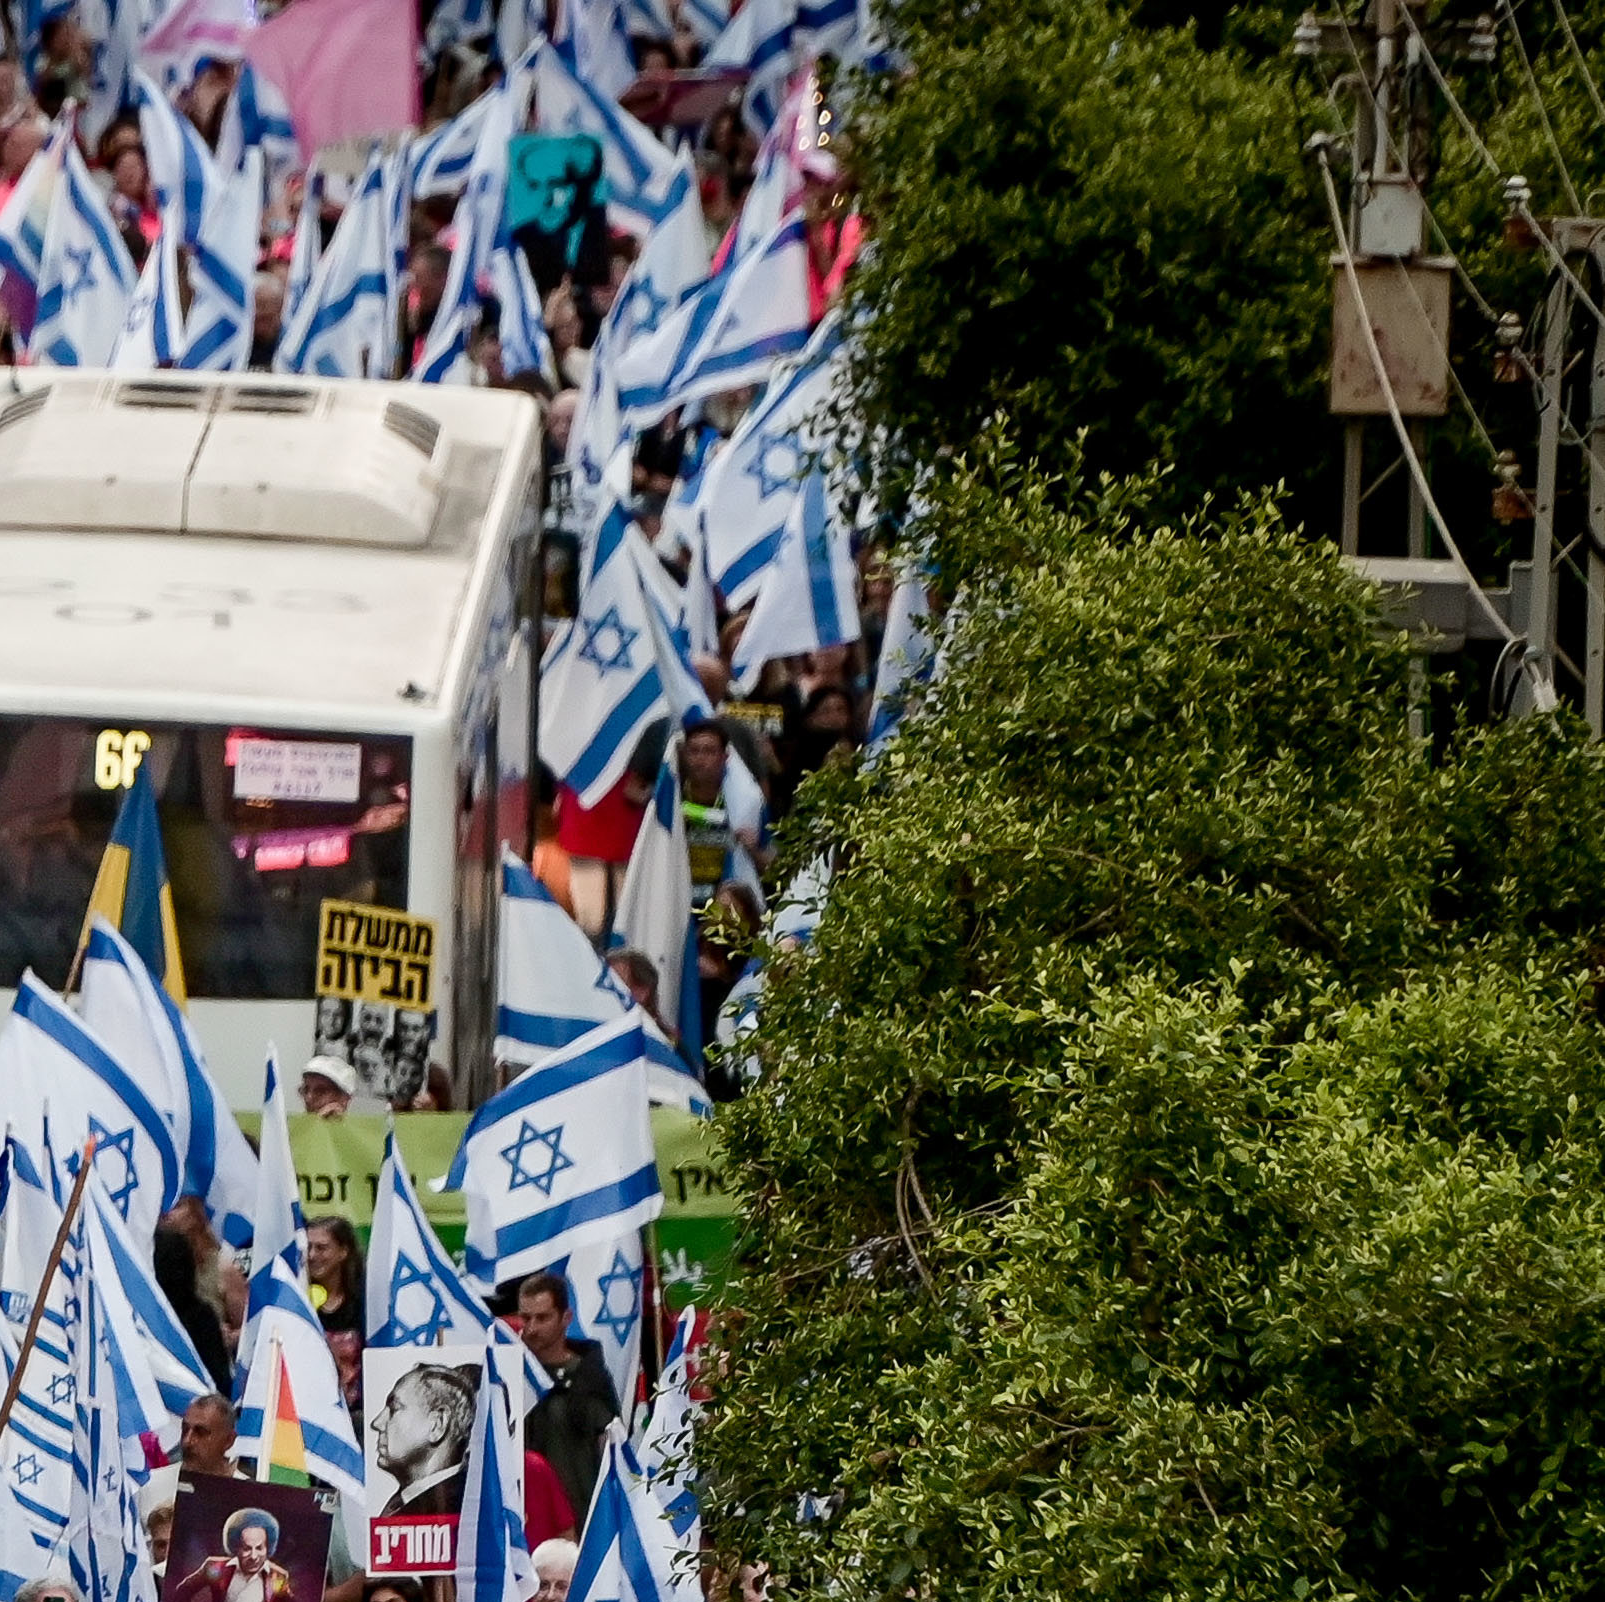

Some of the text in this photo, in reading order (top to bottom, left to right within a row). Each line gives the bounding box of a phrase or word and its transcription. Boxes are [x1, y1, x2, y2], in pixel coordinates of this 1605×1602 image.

[325, 909, 434, 956] ממשלת
[322, 949, 431, 1004] הביזה
[375, 1524, 452, 1564] מחריב
